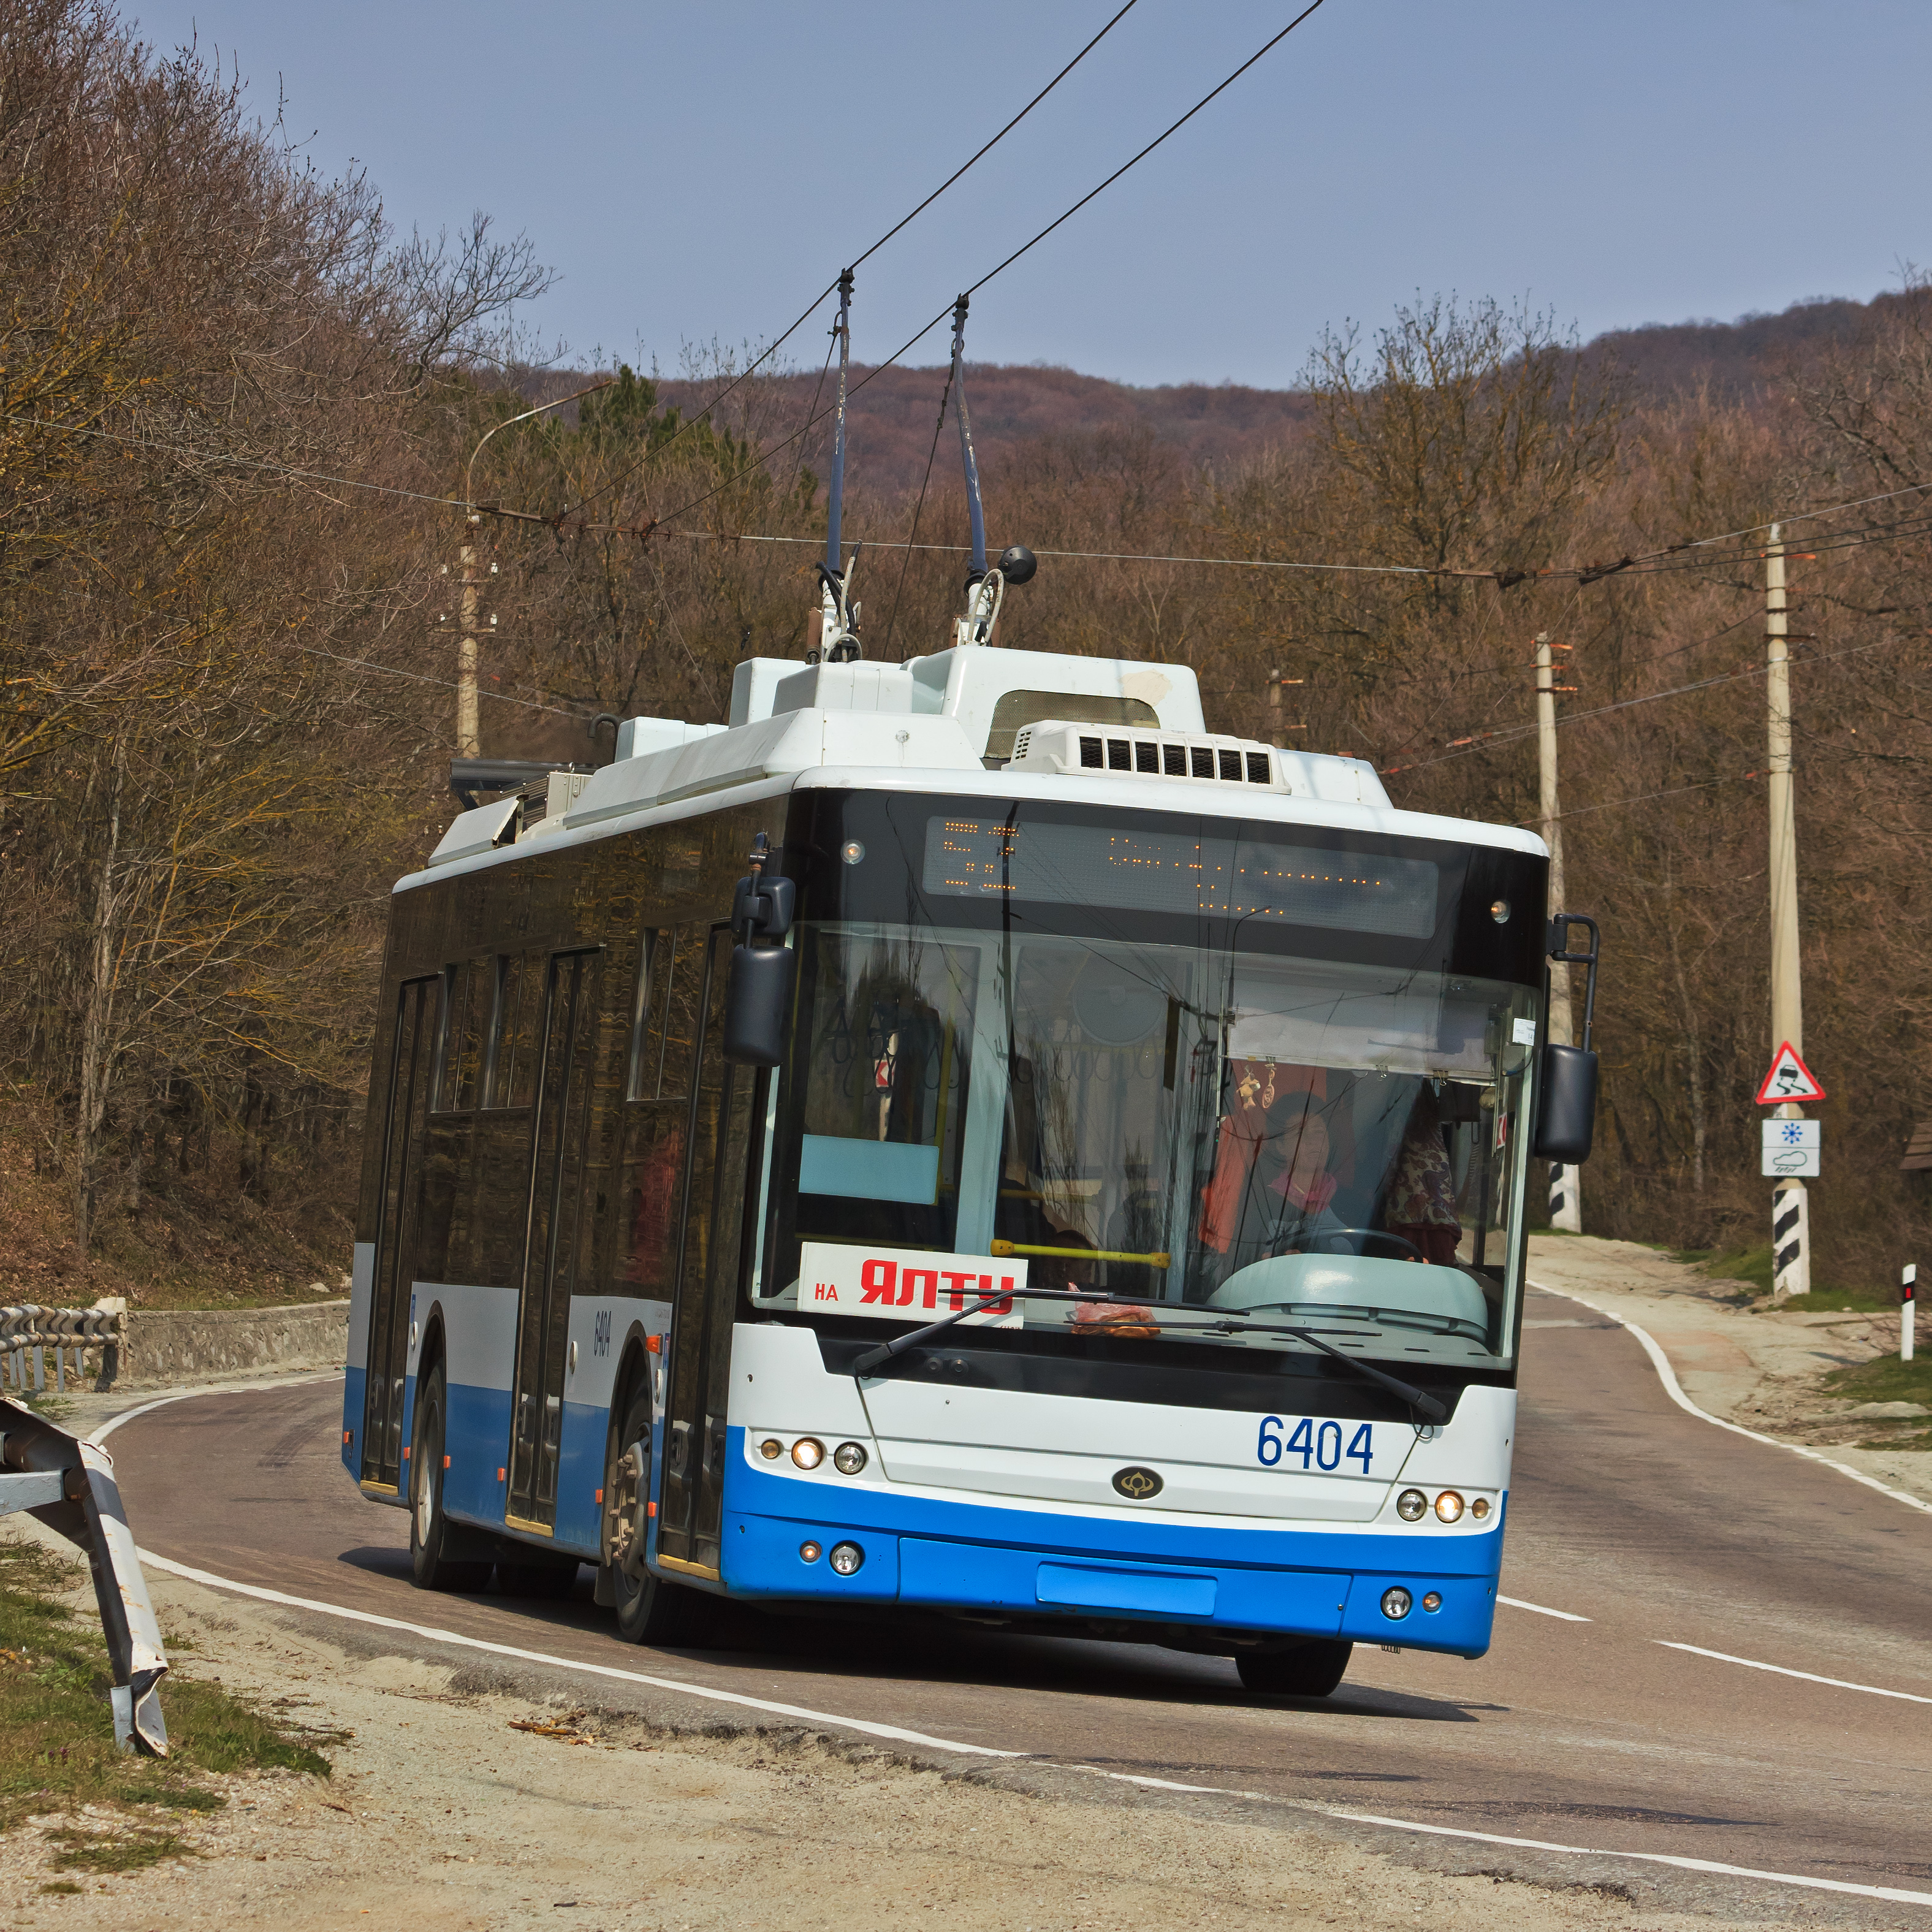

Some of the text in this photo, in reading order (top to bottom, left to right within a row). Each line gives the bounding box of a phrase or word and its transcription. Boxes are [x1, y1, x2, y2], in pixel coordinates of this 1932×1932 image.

[815, 1258, 1015, 1315] НА ЯЛТУ
[594, 1310, 612, 1358] 6404
[1257, 1415, 1374, 1475] 6404
